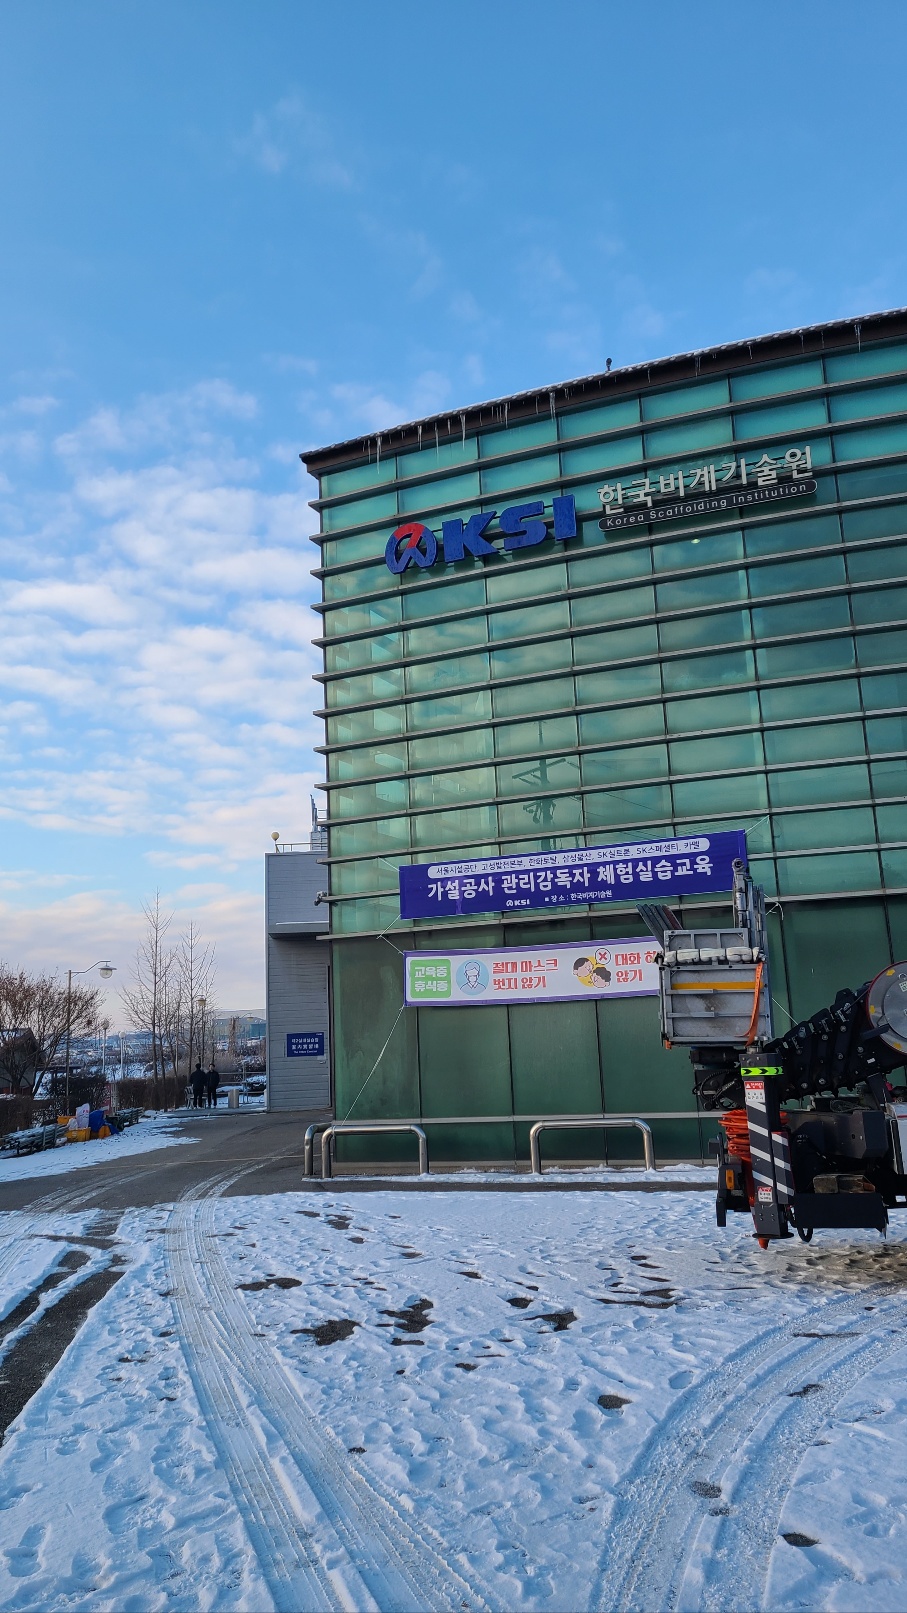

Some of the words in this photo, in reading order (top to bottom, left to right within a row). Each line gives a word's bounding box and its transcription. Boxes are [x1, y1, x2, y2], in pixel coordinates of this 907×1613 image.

[597, 446, 813, 514] 한국비계기술원
[605, 513, 645, 528] Korea
[649, 498, 728, 521] Scaffolding
[731, 483, 808, 505] Institution
[442, 495, 577, 563] KSI
[427, 876, 495, 901] 가설공사
[501, 868, 591, 895] 관리감독자
[596, 855, 714, 885] 체험실습교육
[492, 960, 518, 974] 절대
[520, 957, 558, 973] 마스크
[614, 951, 642, 966] 대화
[644, 950, 657, 964] 하
[414, 966, 448, 978] 교육중
[615, 969, 643, 983] 않기
[414, 980, 448, 992] 휴식중
[492, 977, 518, 990] 벗지
[521, 975, 547, 990] 않기
